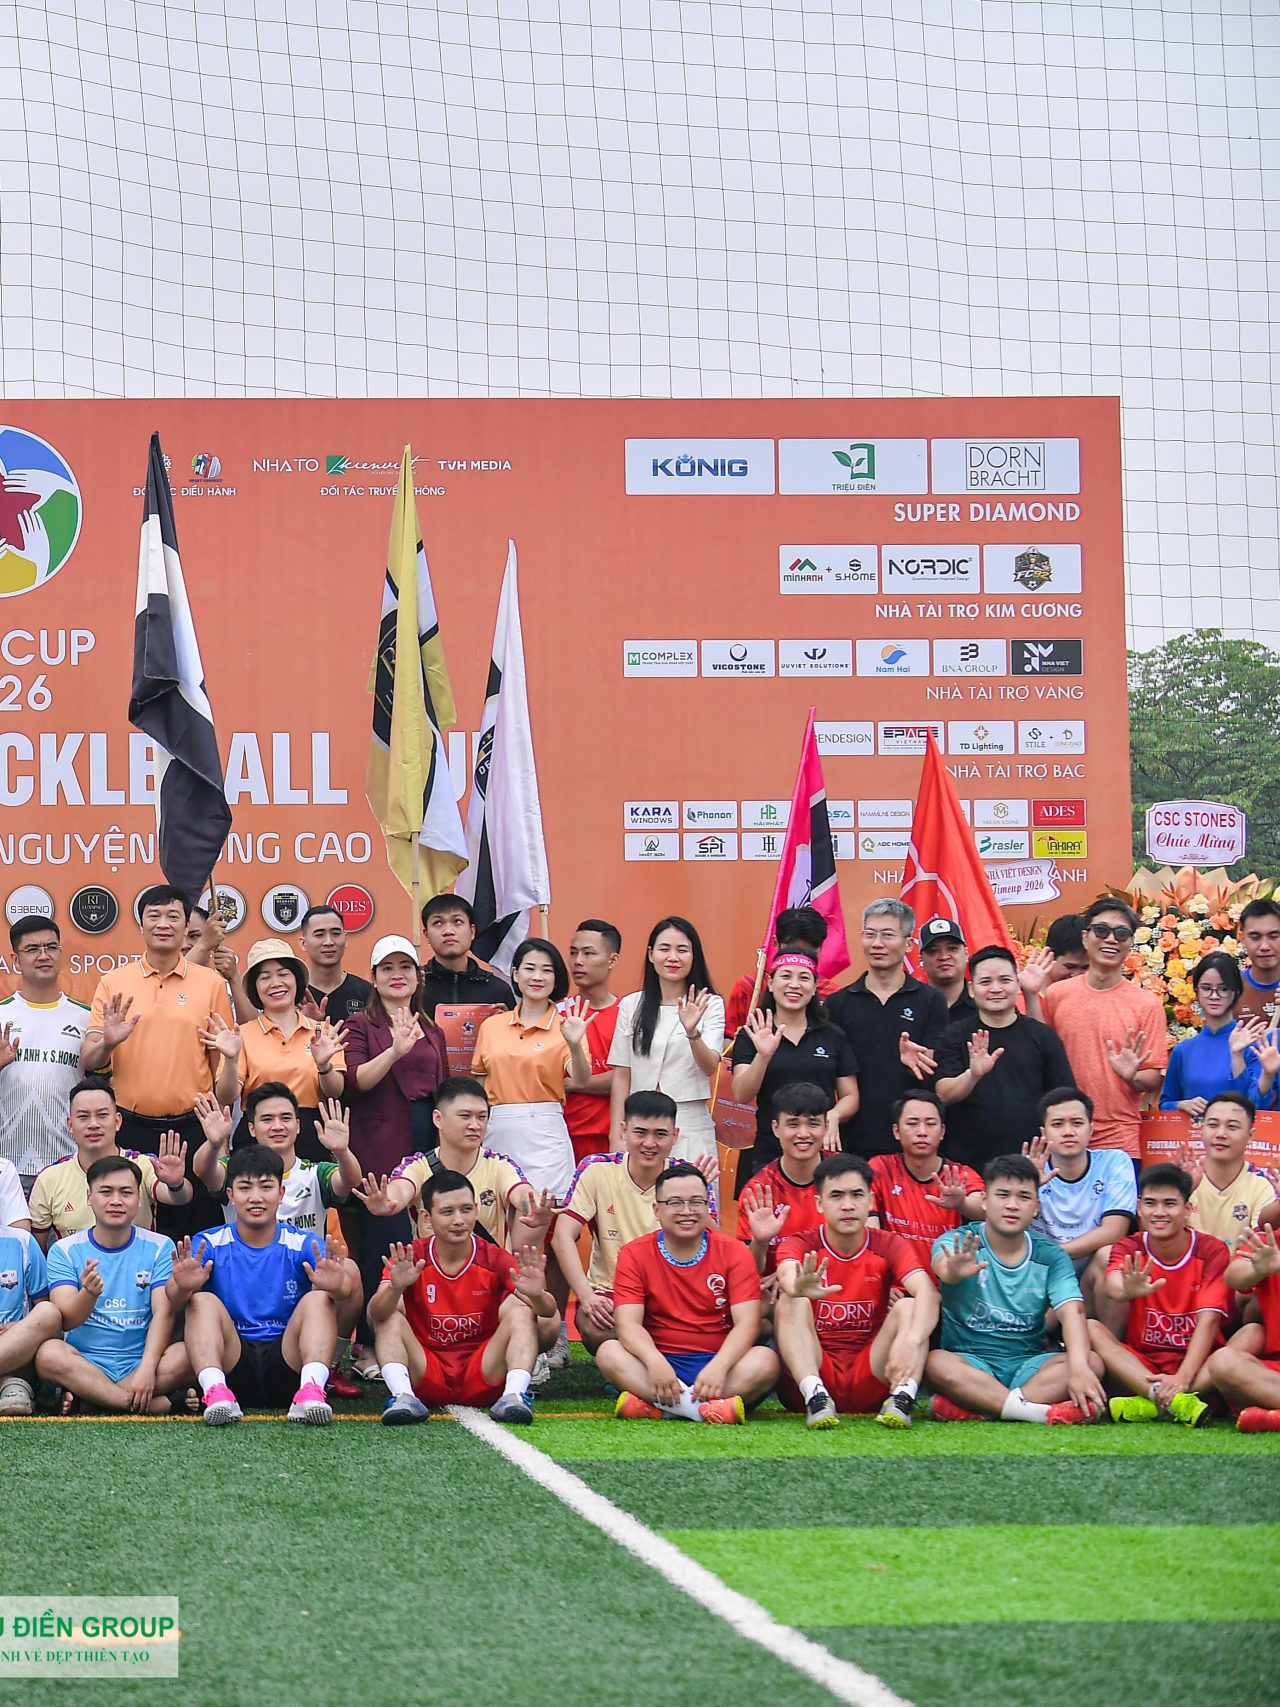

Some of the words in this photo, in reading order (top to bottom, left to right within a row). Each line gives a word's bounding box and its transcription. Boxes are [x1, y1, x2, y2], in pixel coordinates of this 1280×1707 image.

[470, 460, 512, 471] MEDIA
[969, 446, 1041, 469] DORN
[969, 470, 1041, 487] BRACHT
[181, 484, 204, 496] ĐIỀU
[207, 485, 236, 496] HÀNH
[320, 484, 340, 496] ĐỐI
[343, 485, 365, 496] TÁC
[413, 484, 446, 496] HÔNG
[893, 502, 961, 522] SUPER
[969, 502, 1081, 522] DIAMOND
[874, 600, 913, 619] NHÀ
[917, 600, 942, 619] TÀI
[947, 603, 980, 621] TRỢ
[985, 604, 1016, 618] KIM
[1020, 602, 1083, 618] CƯƠNG
[0, 628, 97, 667] CUP
[641, 651, 694, 662] COMPLEX
[711, 663, 766, 671] VICOSTONE
[965, 664, 998, 673] GROUP
[925, 682, 963, 701] NHÀ
[967, 682, 993, 700] TÀI
[997, 684, 1030, 702] TRỢ
[1034, 682, 1085, 700] VÀNG
[959, 742, 971, 750] TD
[971, 742, 1004, 752] Lighting
[986, 761, 1012, 779] TÀI
[1015, 763, 1049, 781] TRỢ
[1053, 763, 1086, 780] BẠC
[1039, 805, 1076, 818] ADES
[1154, 811, 1181, 827] CSC
[1184, 811, 1237, 828] STONES
[293, 831, 373, 864] CAO
[1024, 879, 1045, 892] 2026
[23, 1047, 41, 1063] ANH
[426, 1284, 437, 1304] 9
[103, 1297, 128, 1309] CSC
[818, 1302, 871, 1322] DORN
[430, 1313, 482, 1332] DORN
[1144, 1329, 1192, 1348] BRACH
